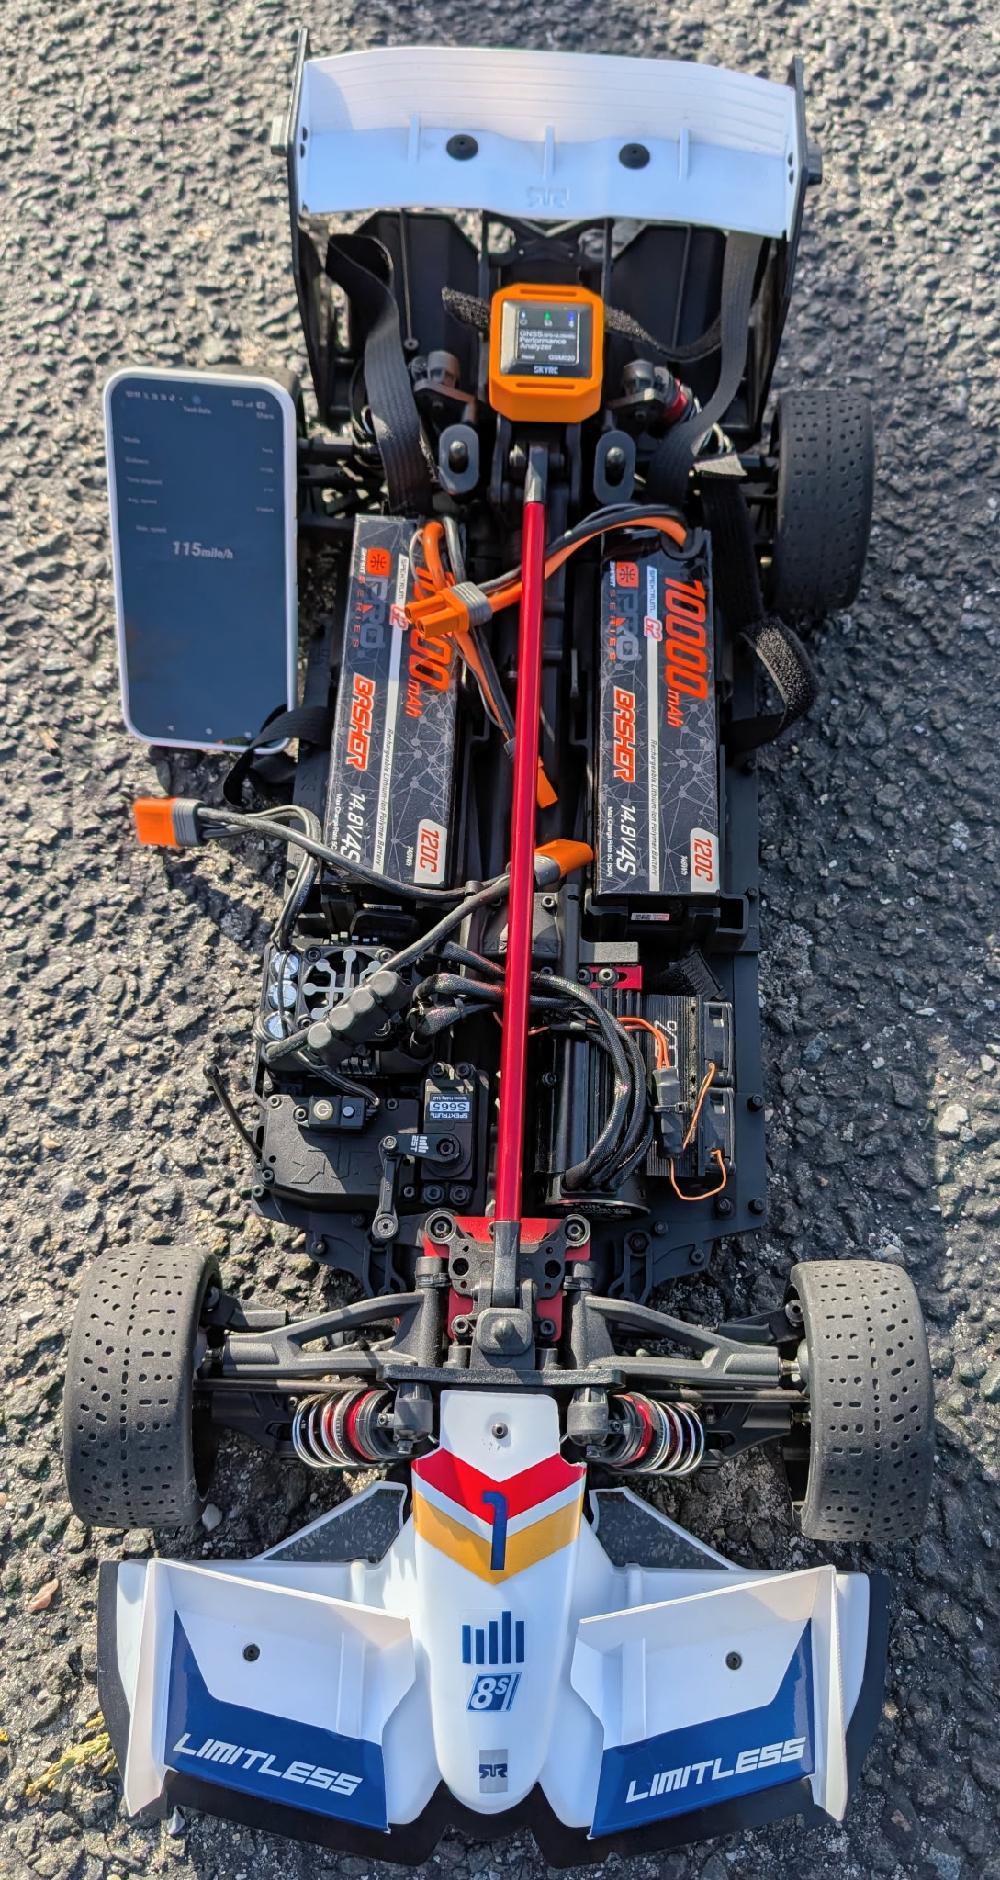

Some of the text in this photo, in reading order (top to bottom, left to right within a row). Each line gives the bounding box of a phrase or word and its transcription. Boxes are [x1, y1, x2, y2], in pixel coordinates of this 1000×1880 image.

[519, 336, 567, 345] Performance
[519, 343, 552, 351] Analyzer
[533, 365, 559, 375] SKYRC
[345, 672, 377, 772] BASHER
[613, 685, 636, 783] BASHER
[420, 828, 440, 873] 120C
[693, 838, 713, 882] 120C
[432, 1102, 468, 1111] S665
[410, 1134, 419, 1153] 25T
[470, 1677, 510, 1710] 8S
[173, 1732, 364, 1796] LIMITLESS
[625, 1736, 807, 1804] LIMITLESS
